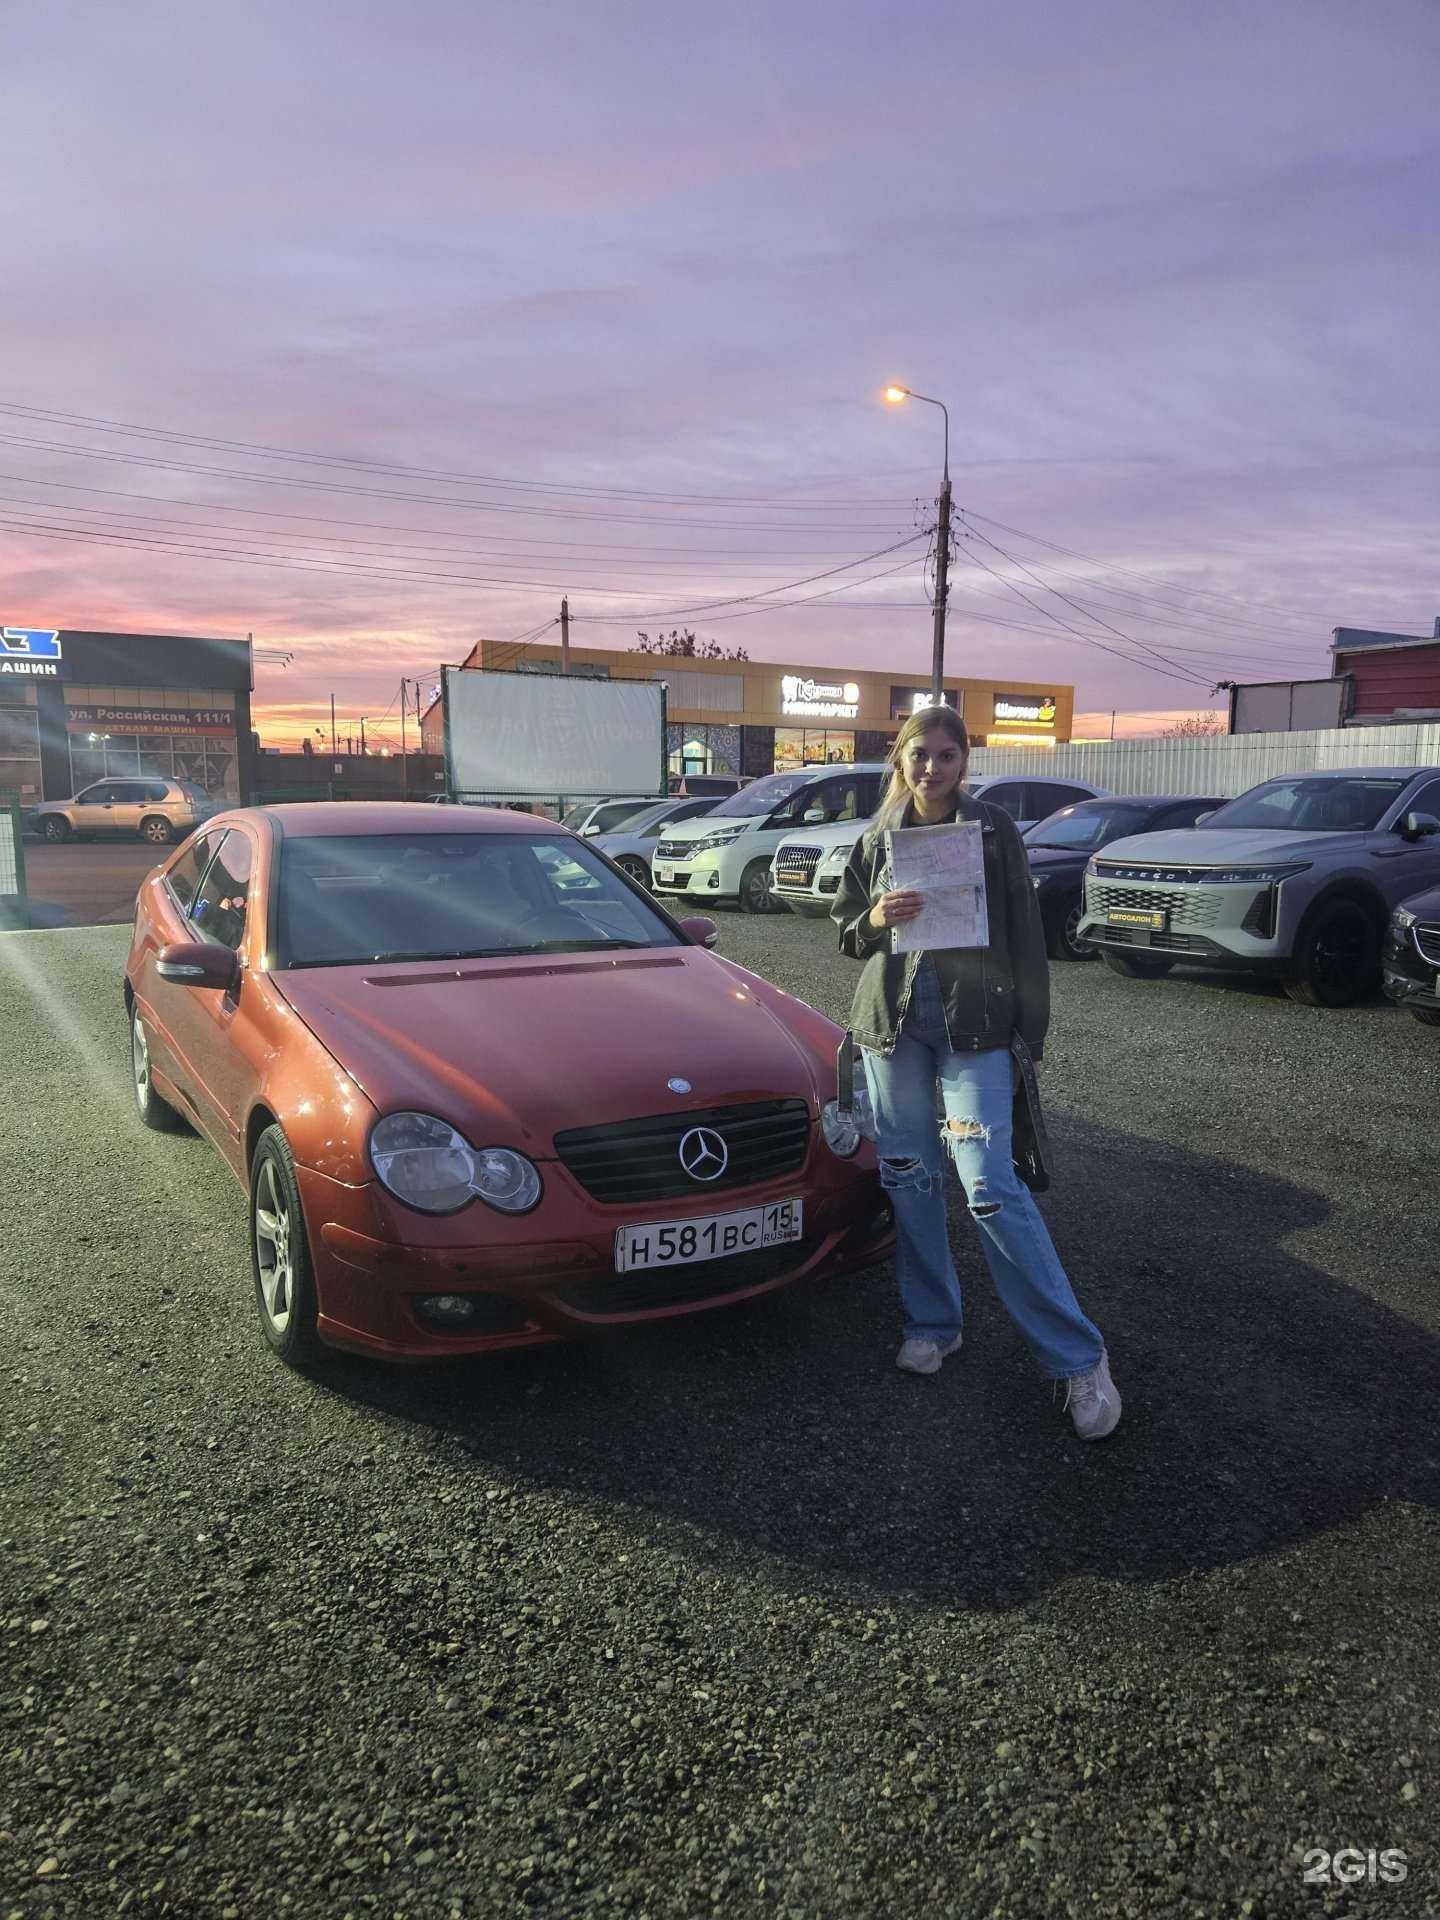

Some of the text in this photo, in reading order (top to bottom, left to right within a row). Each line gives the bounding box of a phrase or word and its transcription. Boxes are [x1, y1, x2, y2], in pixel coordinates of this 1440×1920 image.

[0, 662, 57, 675] АШИН
[68, 708, 92, 721] ул.
[193, 711, 232, 724] 111/1
[1109, 913, 1151, 923] АВТОСАЛОН
[767, 1204, 793, 1231] 15
[763, 1231, 784, 1243] RUS
